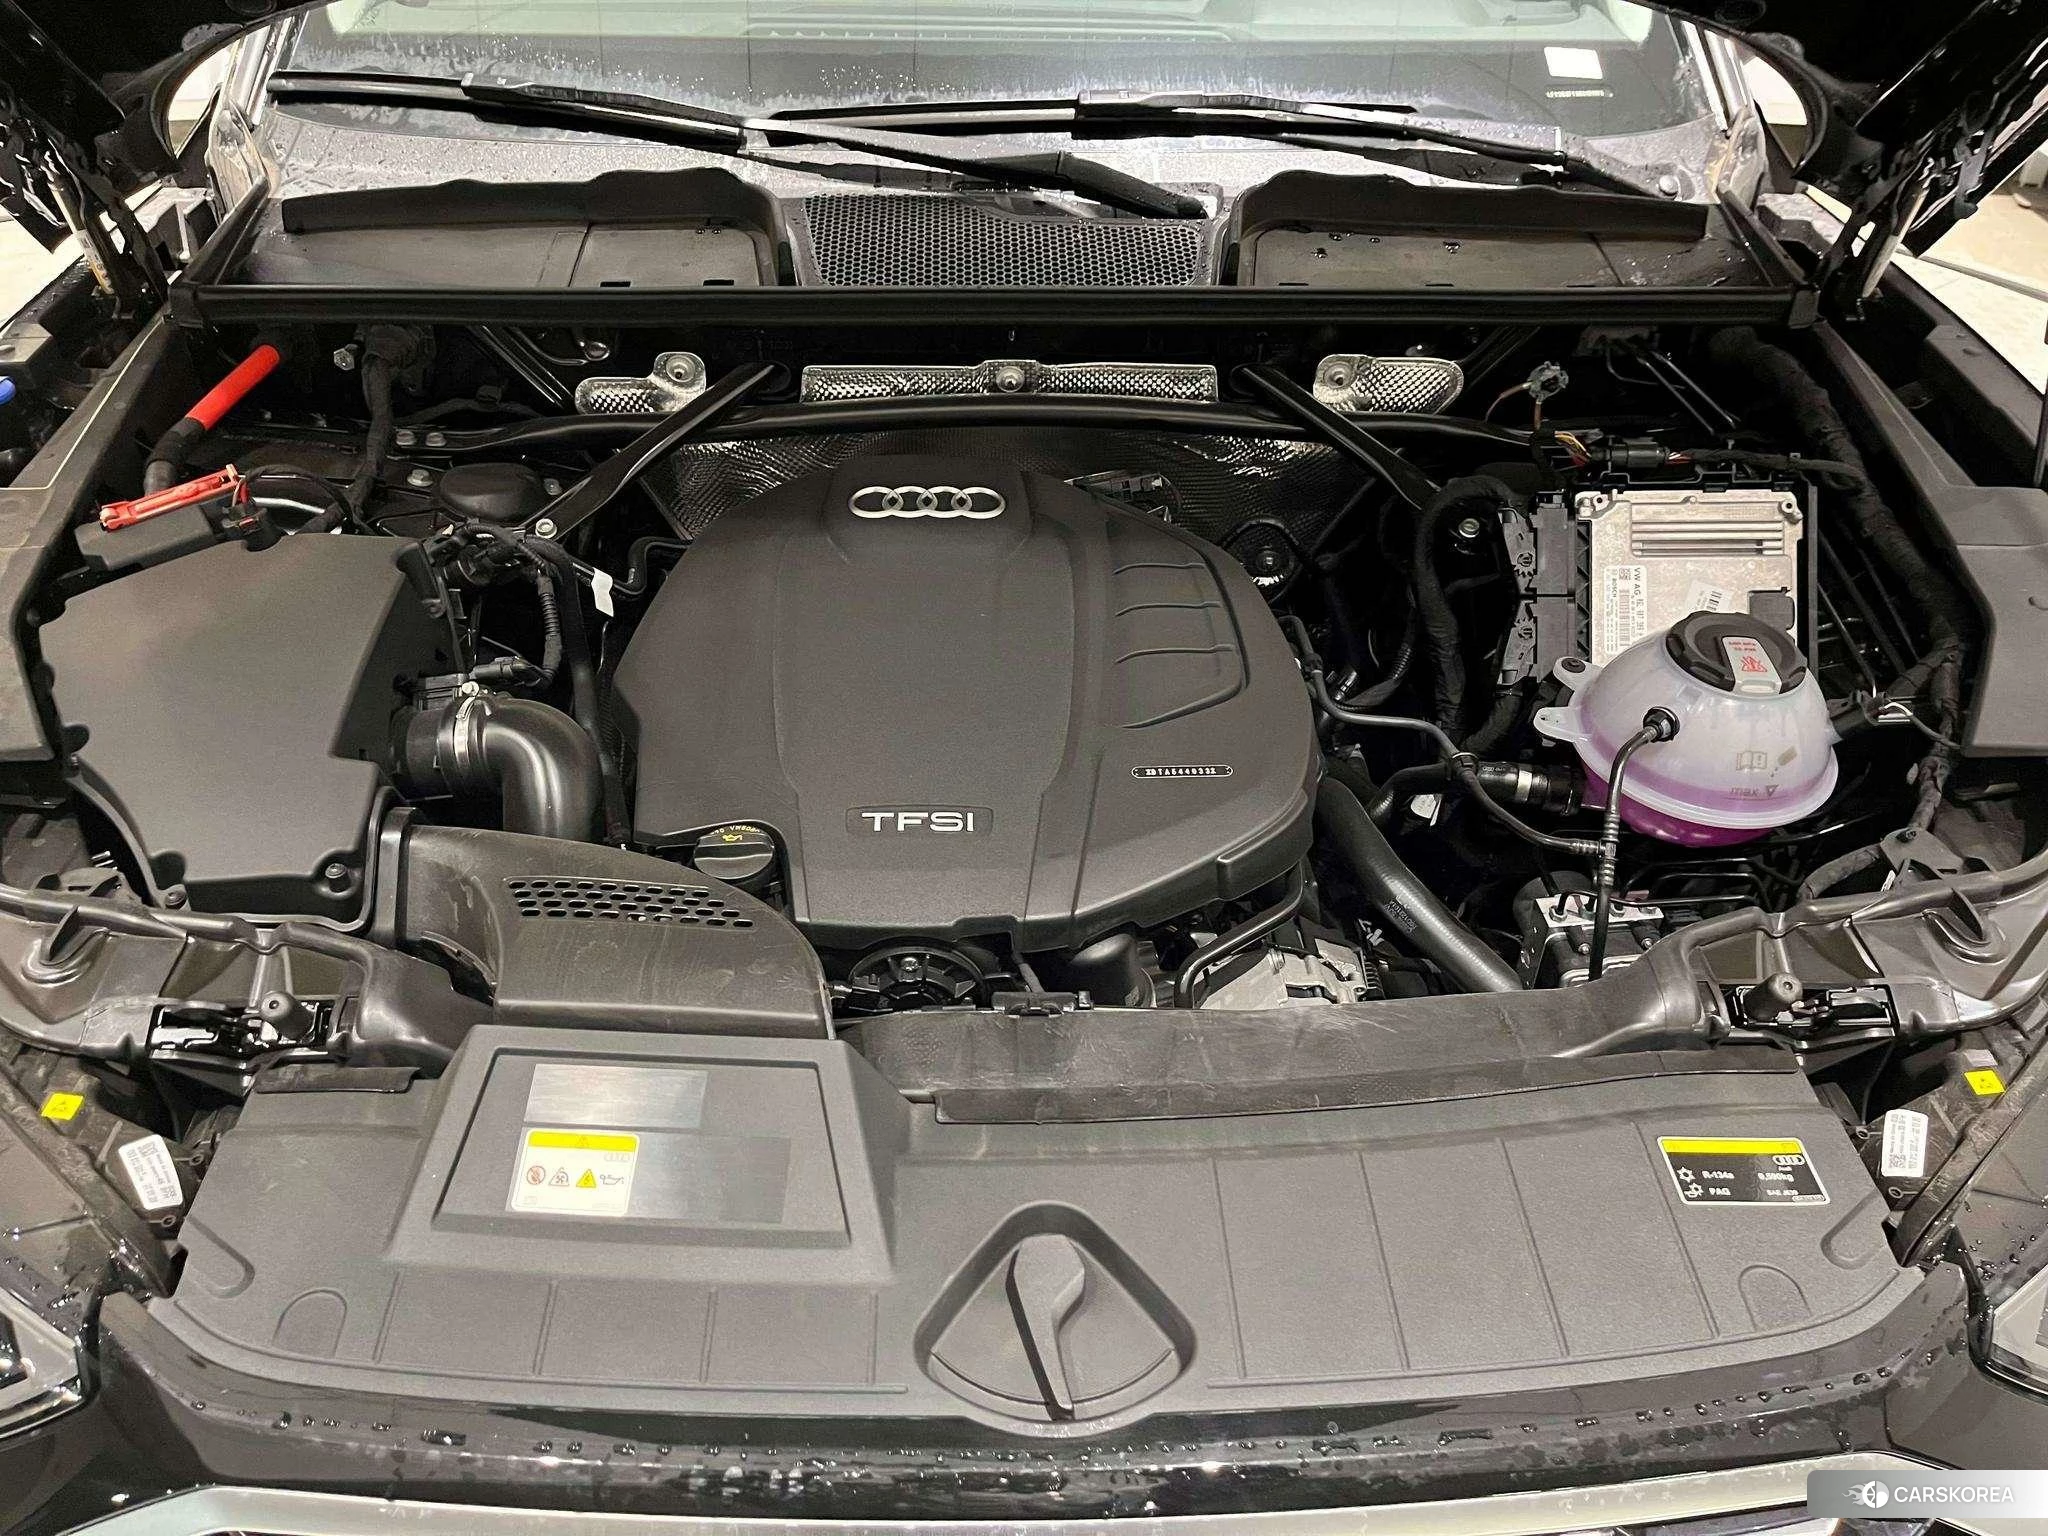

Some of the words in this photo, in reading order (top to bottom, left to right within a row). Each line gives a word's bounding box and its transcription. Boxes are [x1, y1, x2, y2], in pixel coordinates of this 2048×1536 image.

[1634, 583, 1641, 596] AG
[861, 811, 974, 832] TFSI
[1709, 1188, 1731, 1196] PAG
